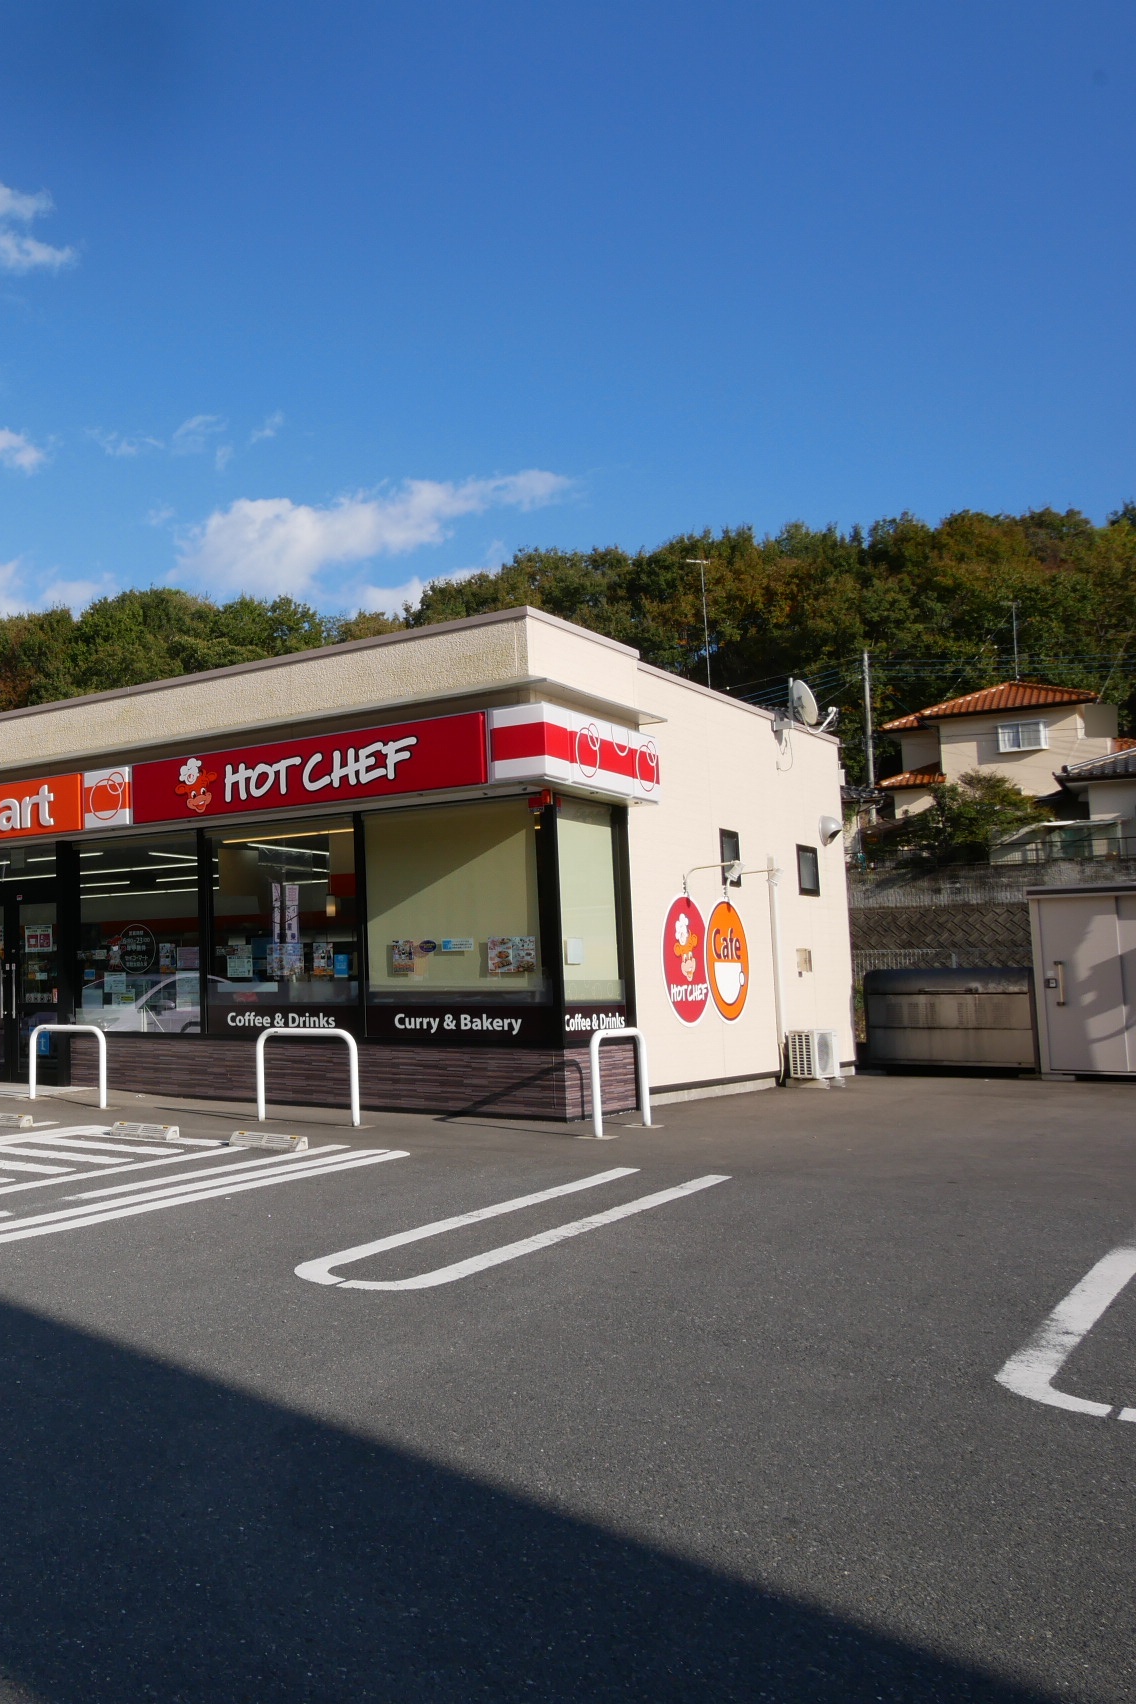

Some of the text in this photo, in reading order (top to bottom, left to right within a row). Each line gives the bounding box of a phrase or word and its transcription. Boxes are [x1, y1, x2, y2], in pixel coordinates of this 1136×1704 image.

[224, 736, 417, 803] HOT CHEF
[711, 927, 741, 961] Cafe
[670, 983, 708, 1002] HOT CHEF
[227, 1012, 336, 1028] Coffee & Drinks
[394, 1013, 523, 1035] Curry & Bakery
[564, 1012, 626, 1031] Coffee & Drinks
